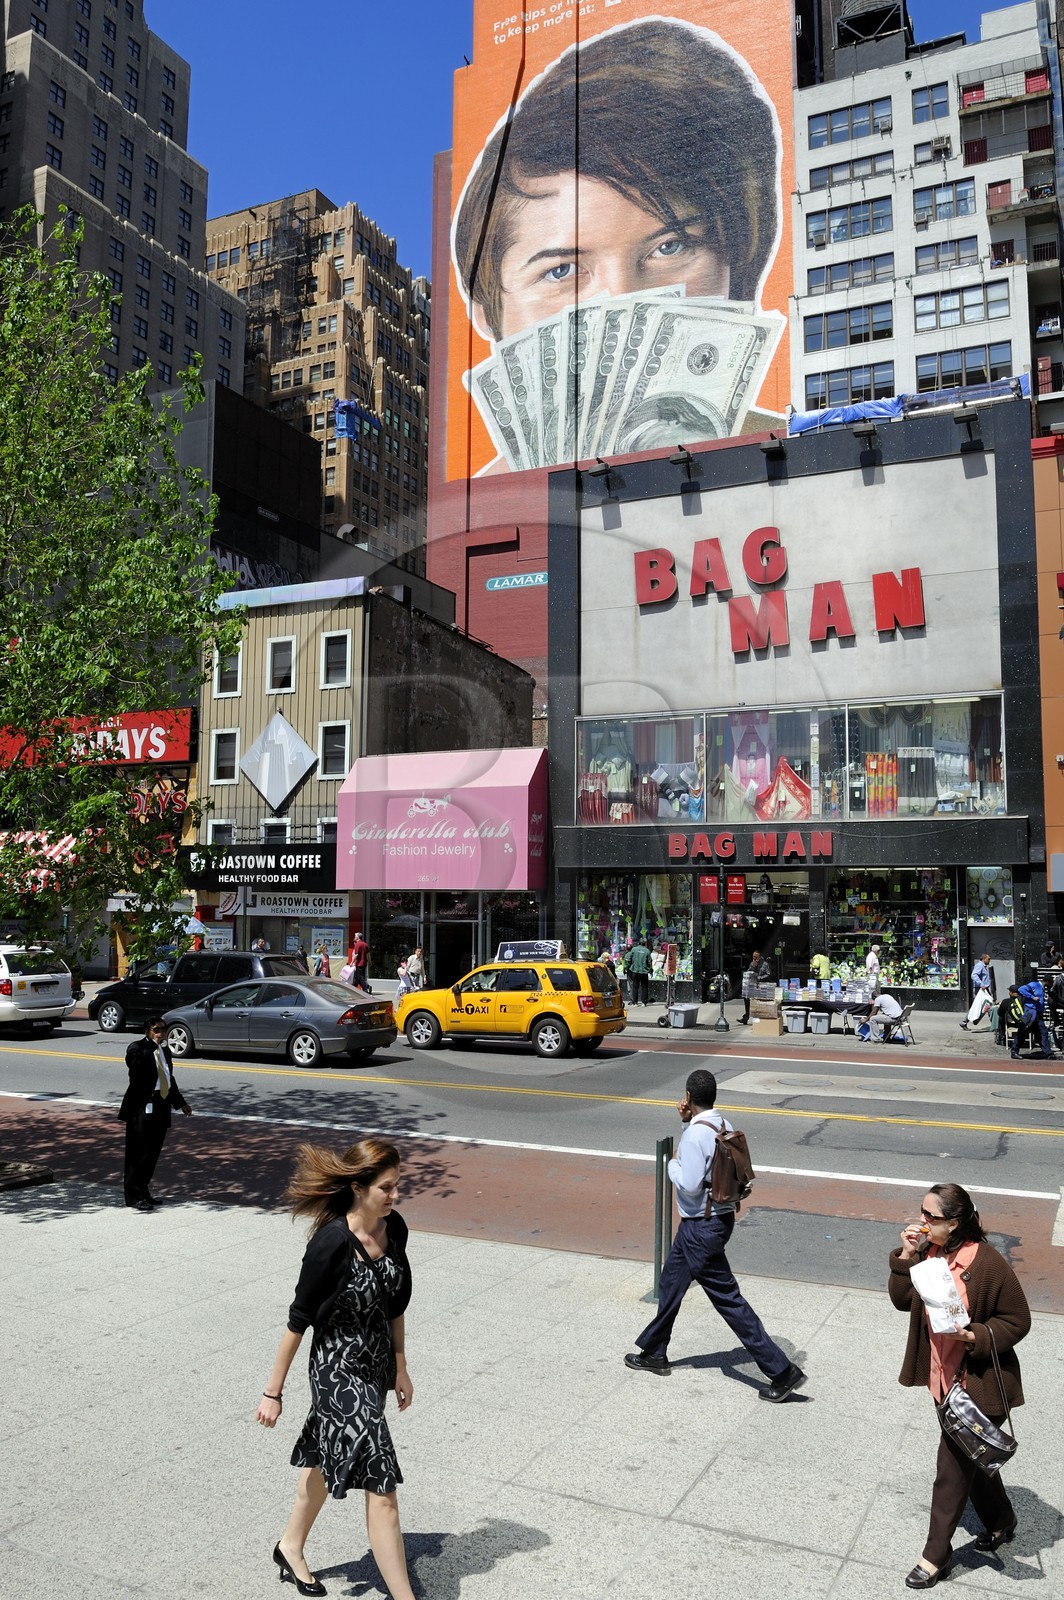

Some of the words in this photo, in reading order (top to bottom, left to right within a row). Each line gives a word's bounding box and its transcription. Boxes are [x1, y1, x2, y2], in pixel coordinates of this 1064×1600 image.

[493, 14, 518, 33] Free
[521, 7, 546, 22] tips
[493, 33, 506, 45] to
[507, 23, 540, 38] keep
[543, 10, 573, 28] more
[579, 4, 595, 16] at:
[634, 526, 788, 605] BAG
[493, 574, 545, 588] LAMAR
[728, 567, 926, 653] MAN
[351, 818, 458, 841] Cinderella
[463, 818, 515, 839] club
[382, 843, 429, 856] Fashion
[430, 843, 476, 858] Jewelry
[668, 832, 736, 858] BAG
[753, 831, 833, 857] MAN
[279, 854, 321, 869] COFFEE
[218, 875, 255, 883] HEALTHY
[256, 875, 280, 883] FOOD
[281, 875, 299, 883] BAR
[260, 896, 309, 907] ROASTOWN
[312, 897, 344, 908] COFFEE
[465, 1003, 489, 1015] TAXI
